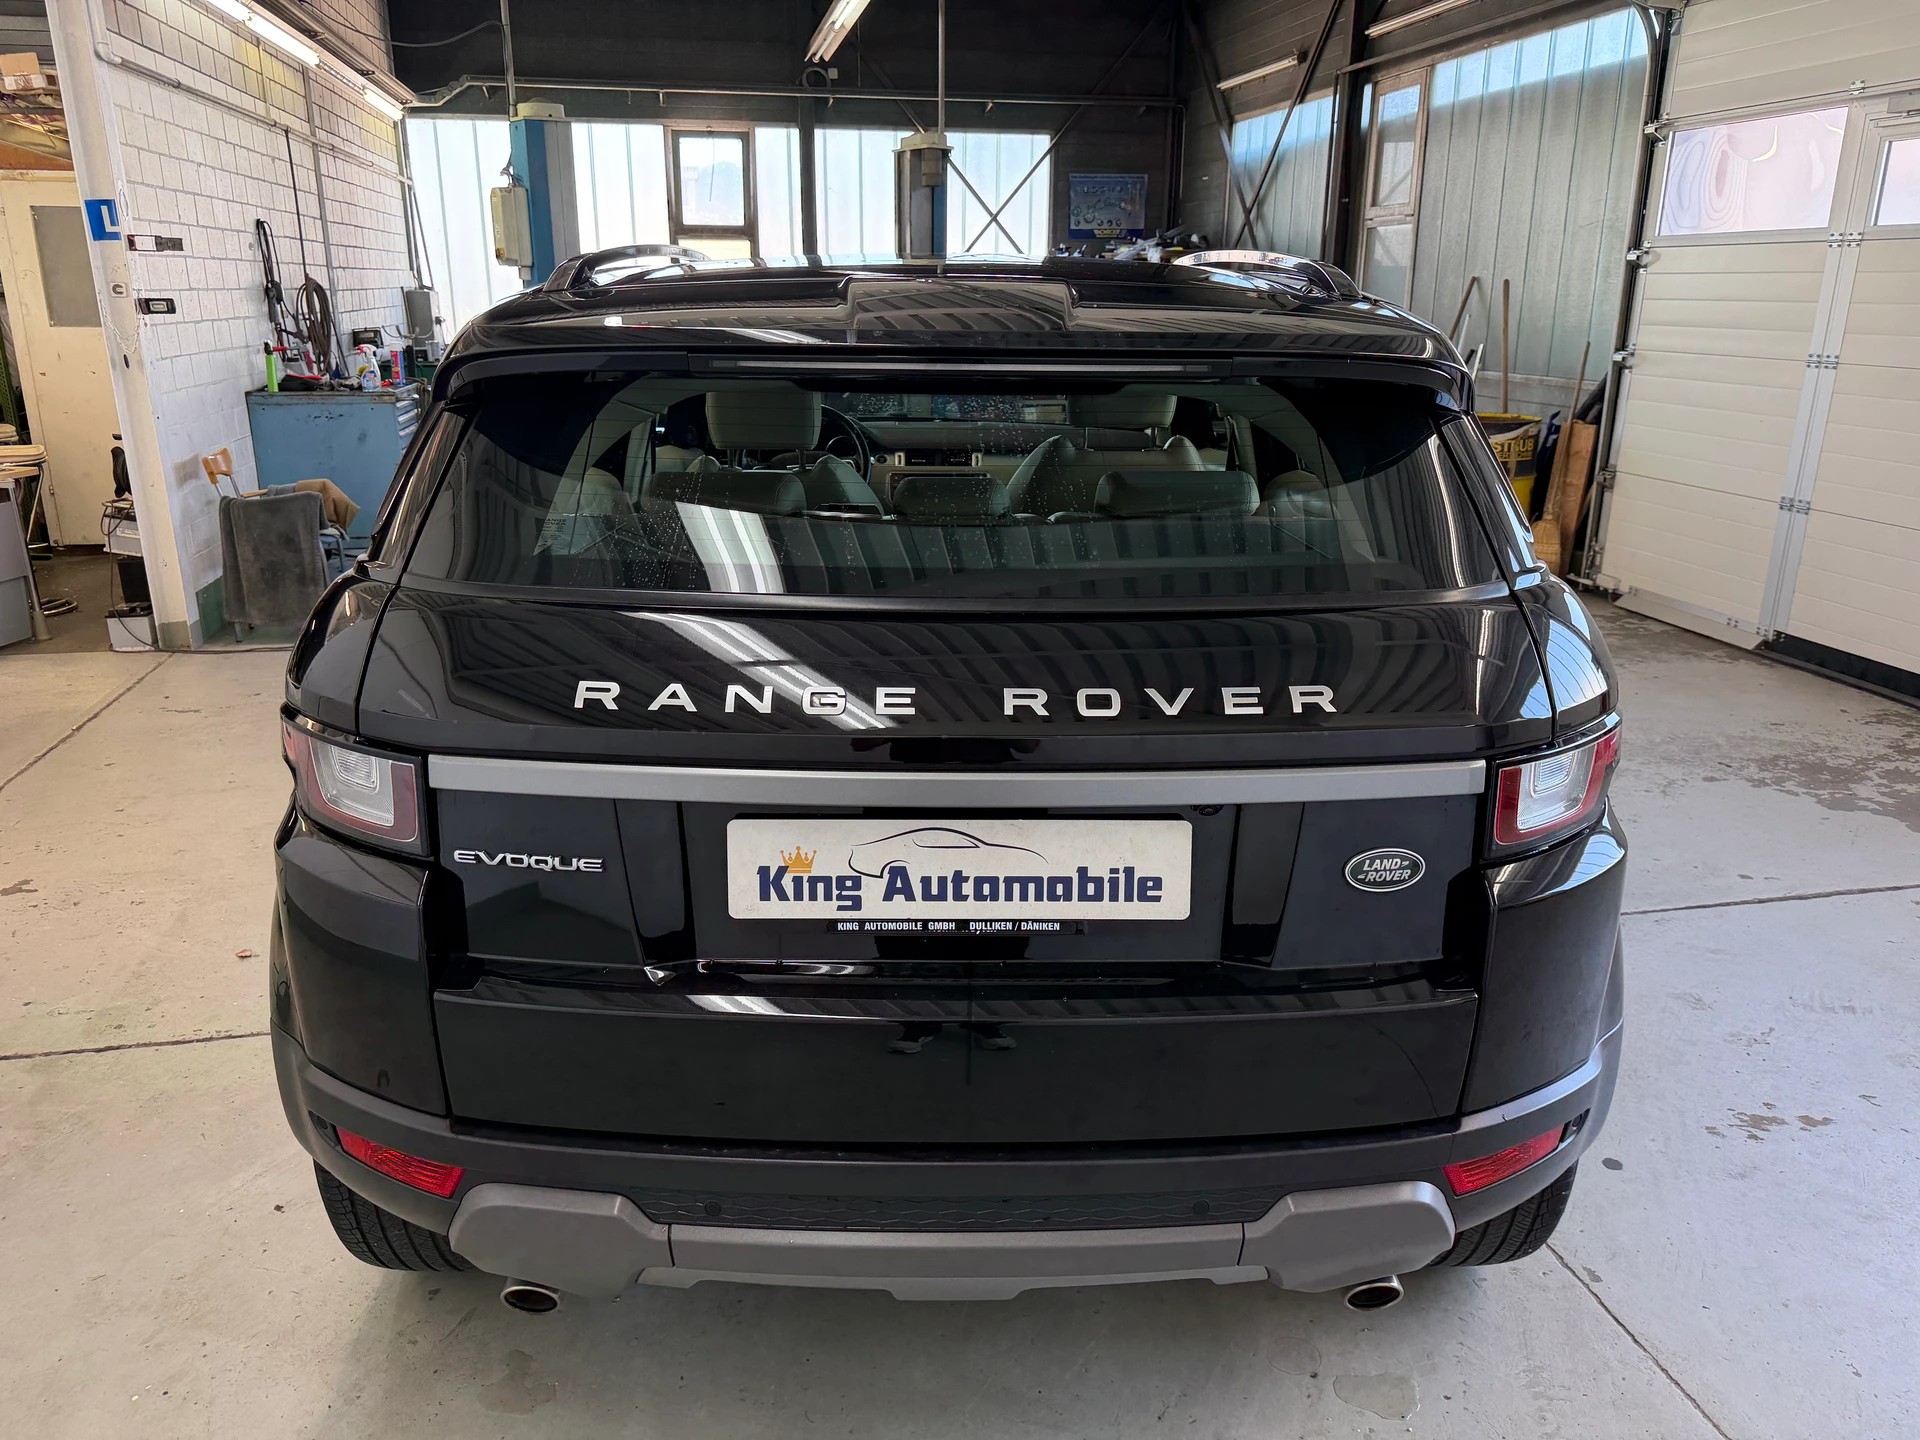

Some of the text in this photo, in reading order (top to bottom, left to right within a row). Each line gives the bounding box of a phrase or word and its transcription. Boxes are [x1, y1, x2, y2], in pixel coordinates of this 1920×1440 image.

[574, 680, 1338, 717] RANGE ROVER
[453, 850, 604, 872] EVOQUE
[1363, 858, 1401, 871] LAND
[1365, 869, 1412, 882] ROVER
[757, 865, 1163, 911] King Automobile
[837, 922, 859, 931] KING
[864, 922, 923, 931] AUTOMOBILE
[928, 921, 956, 931] GMBH
